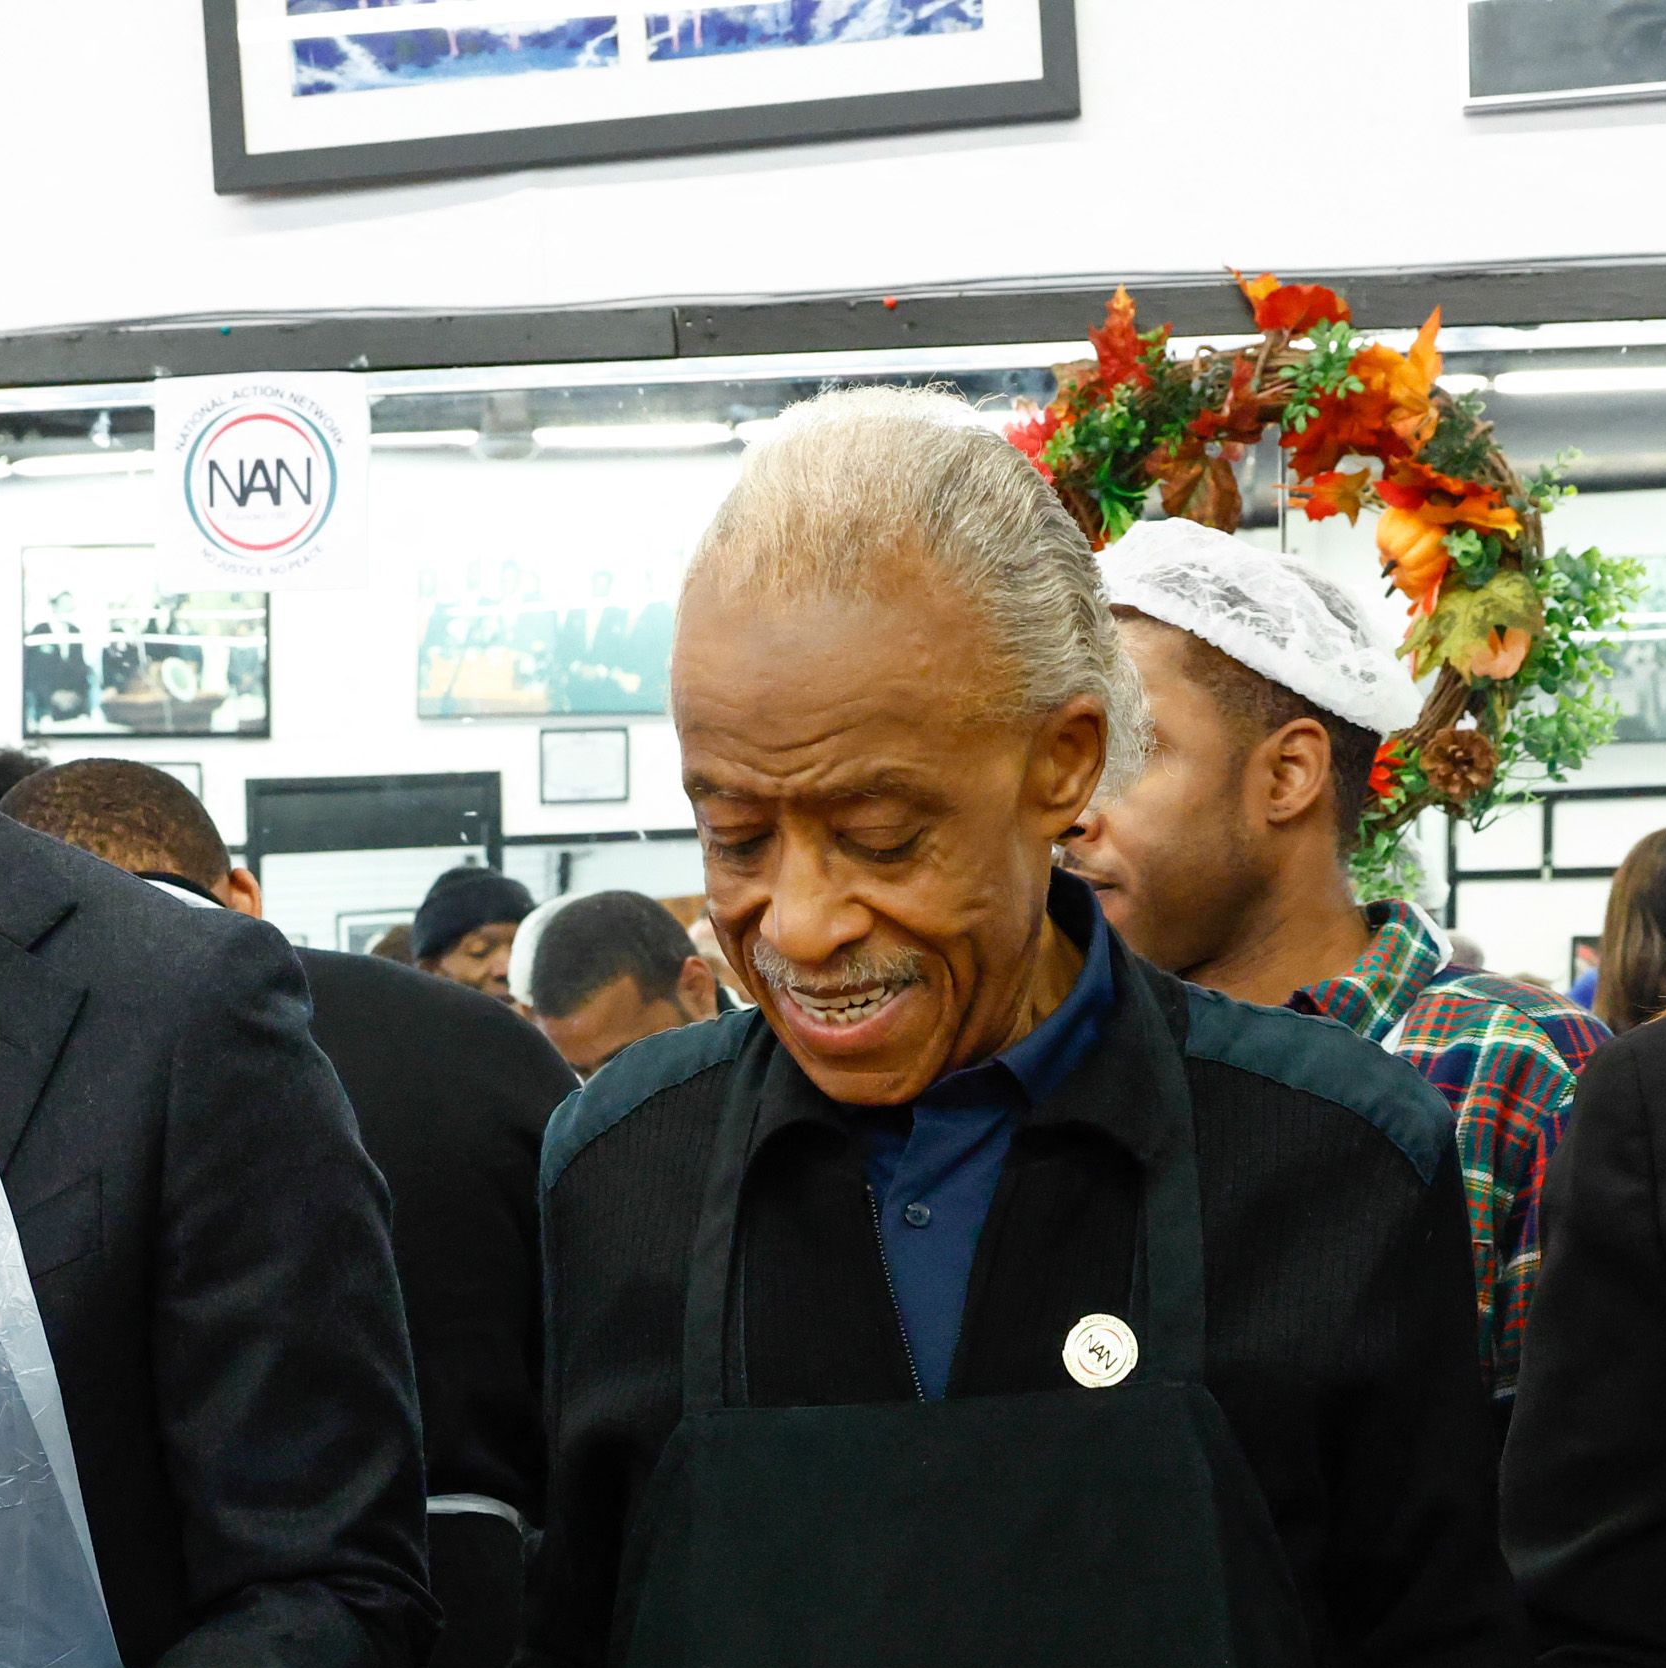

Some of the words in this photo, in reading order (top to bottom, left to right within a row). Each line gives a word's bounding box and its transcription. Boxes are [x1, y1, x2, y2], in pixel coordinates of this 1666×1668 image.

[175, 397, 225, 452] NATIONAL
[231, 385, 286, 400] ACTION
[288, 392, 345, 448] NETWORK
[208, 456, 312, 508] NAN
[1080, 1333, 1119, 1371] NAN
